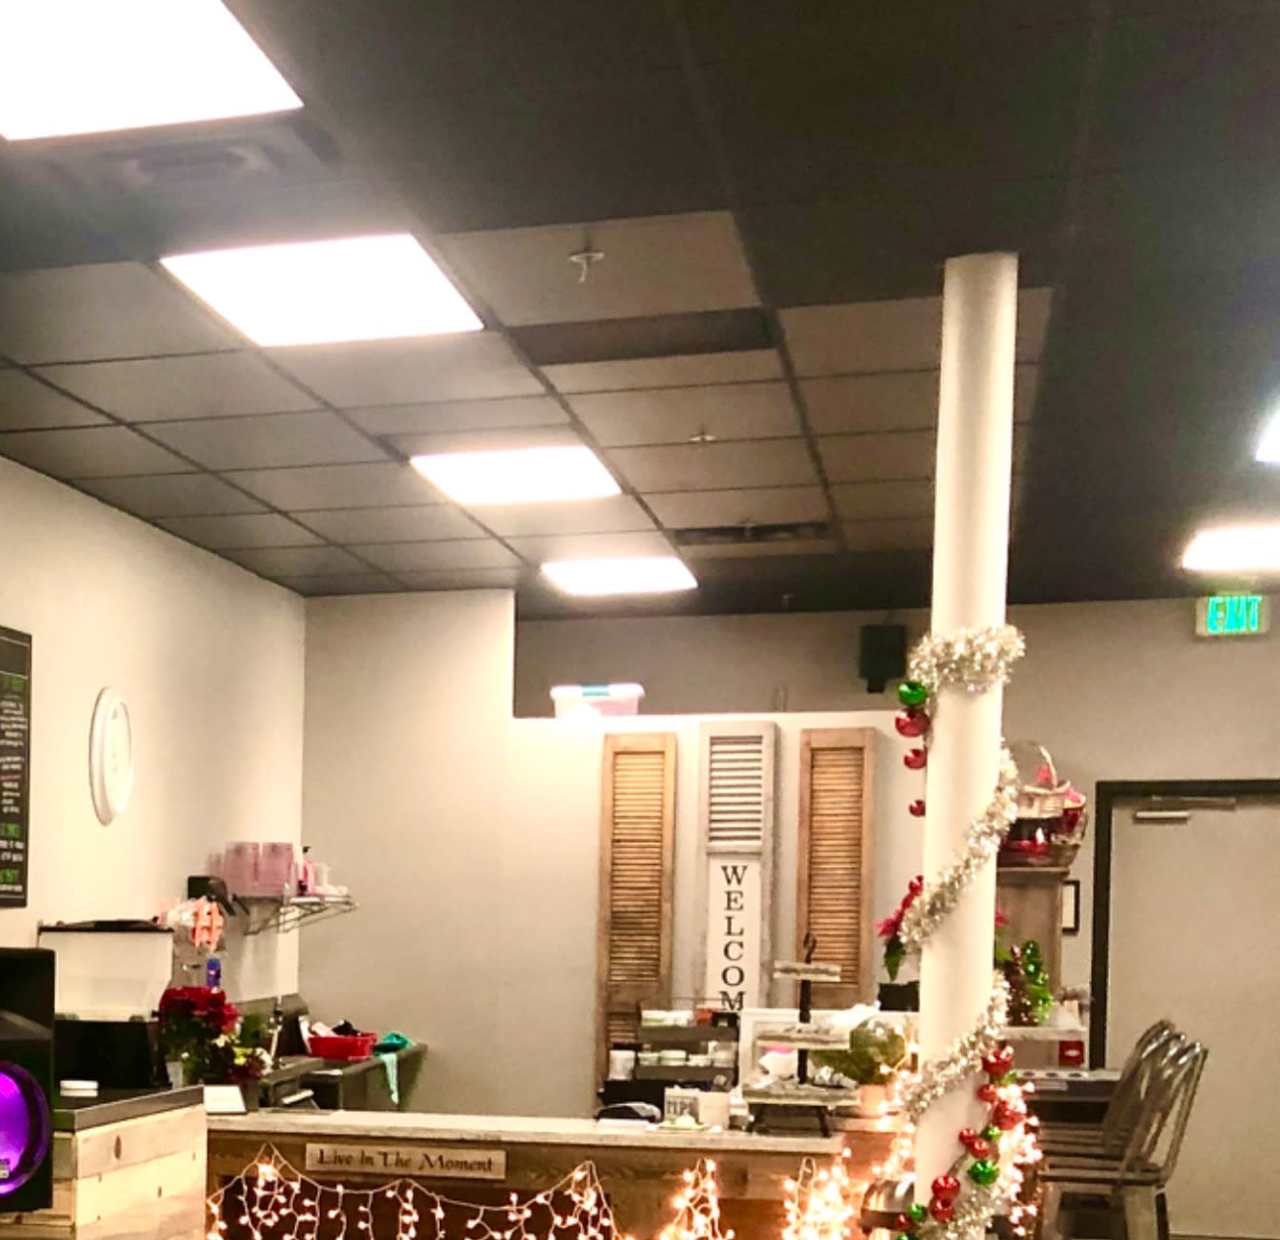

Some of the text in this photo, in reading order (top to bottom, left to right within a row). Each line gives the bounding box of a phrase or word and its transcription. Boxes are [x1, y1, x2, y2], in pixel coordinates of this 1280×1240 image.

[1207, 596, 1262, 634] EXIT
[720, 864, 749, 1011] WELCOM
[317, 1148, 493, 1173] Live In The Moment
